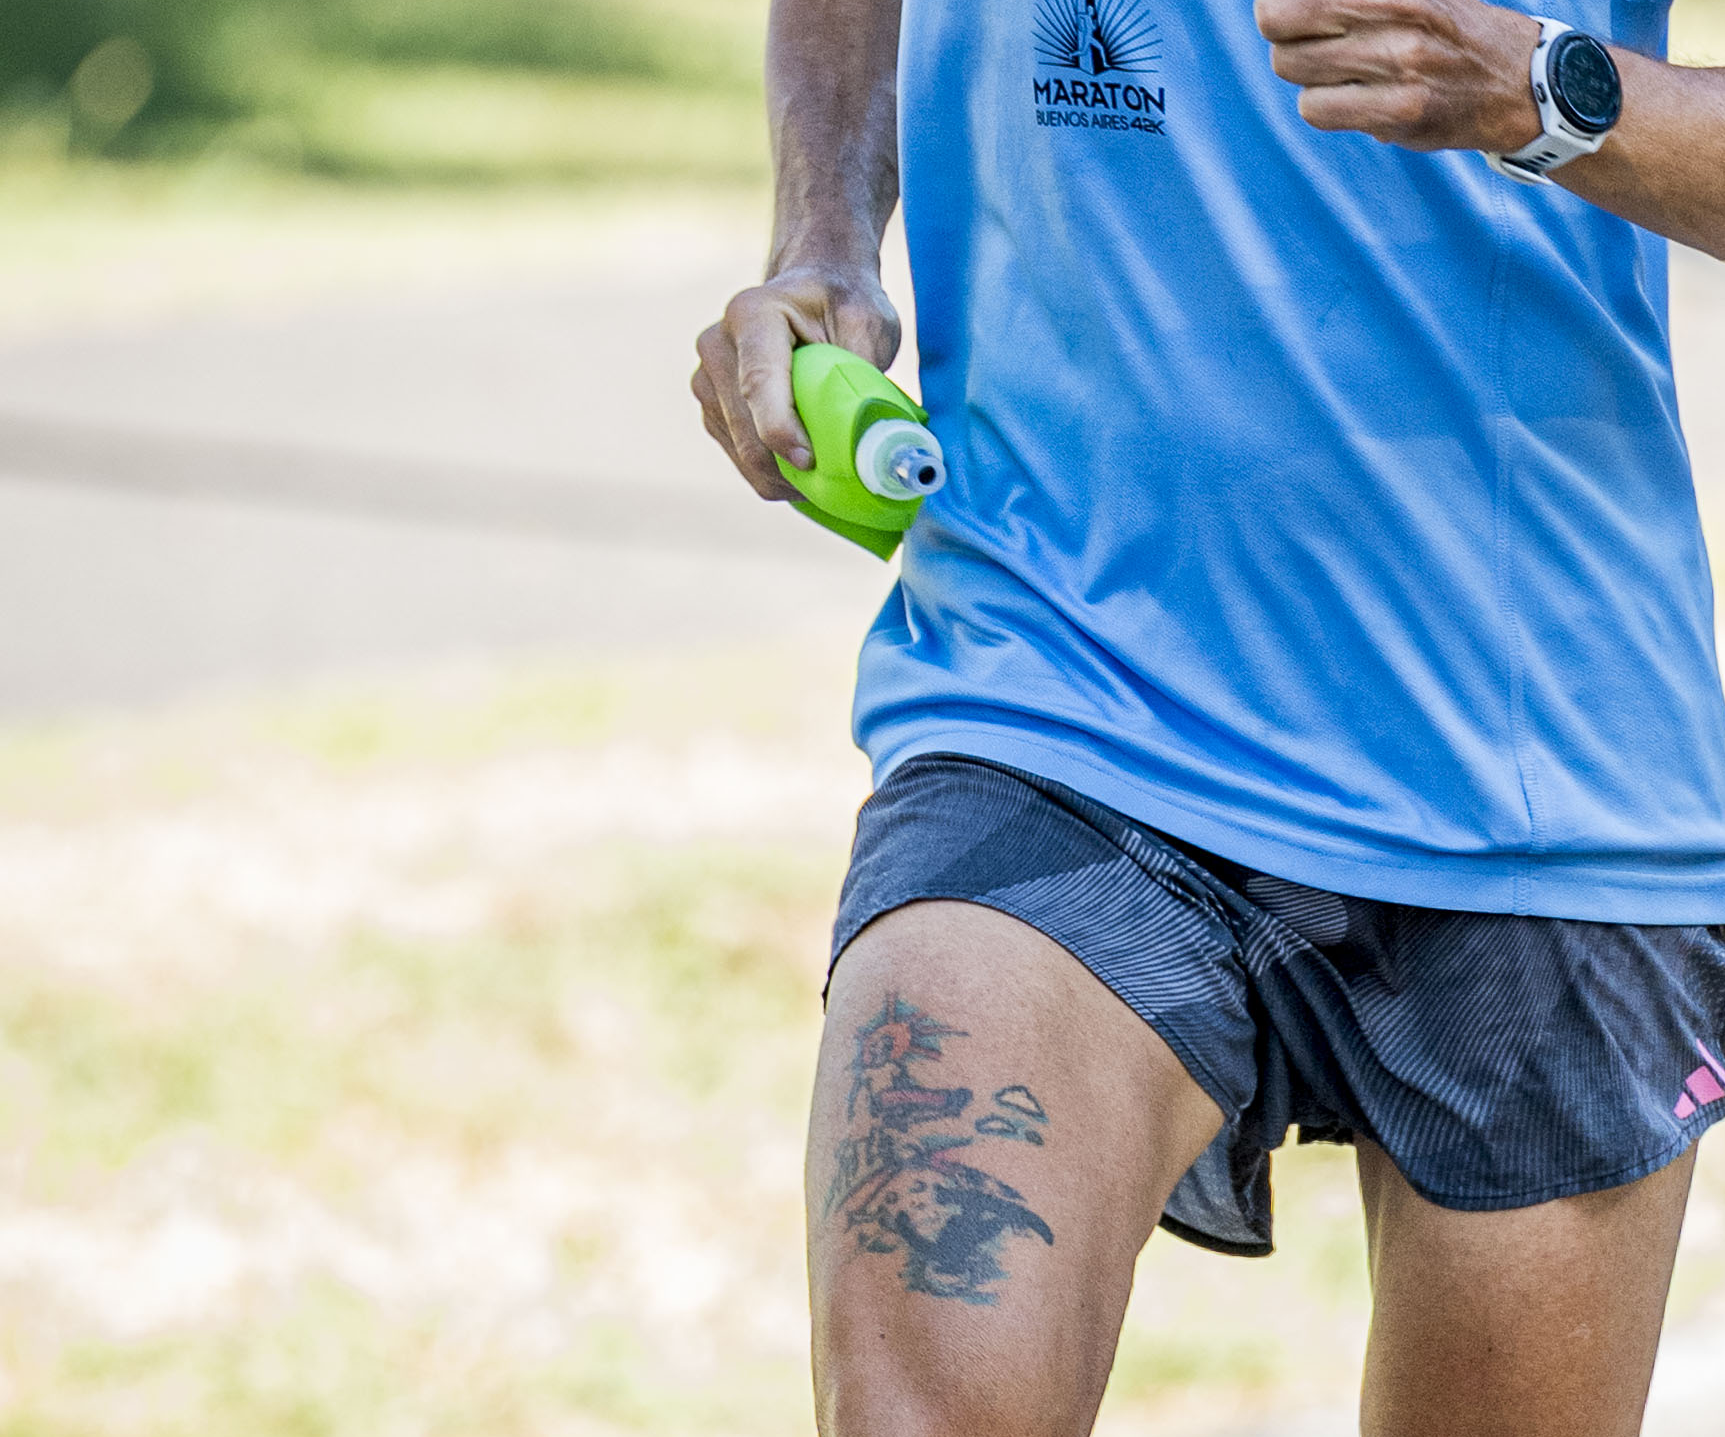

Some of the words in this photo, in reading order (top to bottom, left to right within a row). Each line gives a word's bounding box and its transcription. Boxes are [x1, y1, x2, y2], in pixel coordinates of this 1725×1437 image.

[1033, 77, 1166, 114] MARATON
[1036, 109, 1090, 128] BUENOS
[1091, 113, 1130, 131] AIRES
[1130, 116, 1166, 136] 42K
